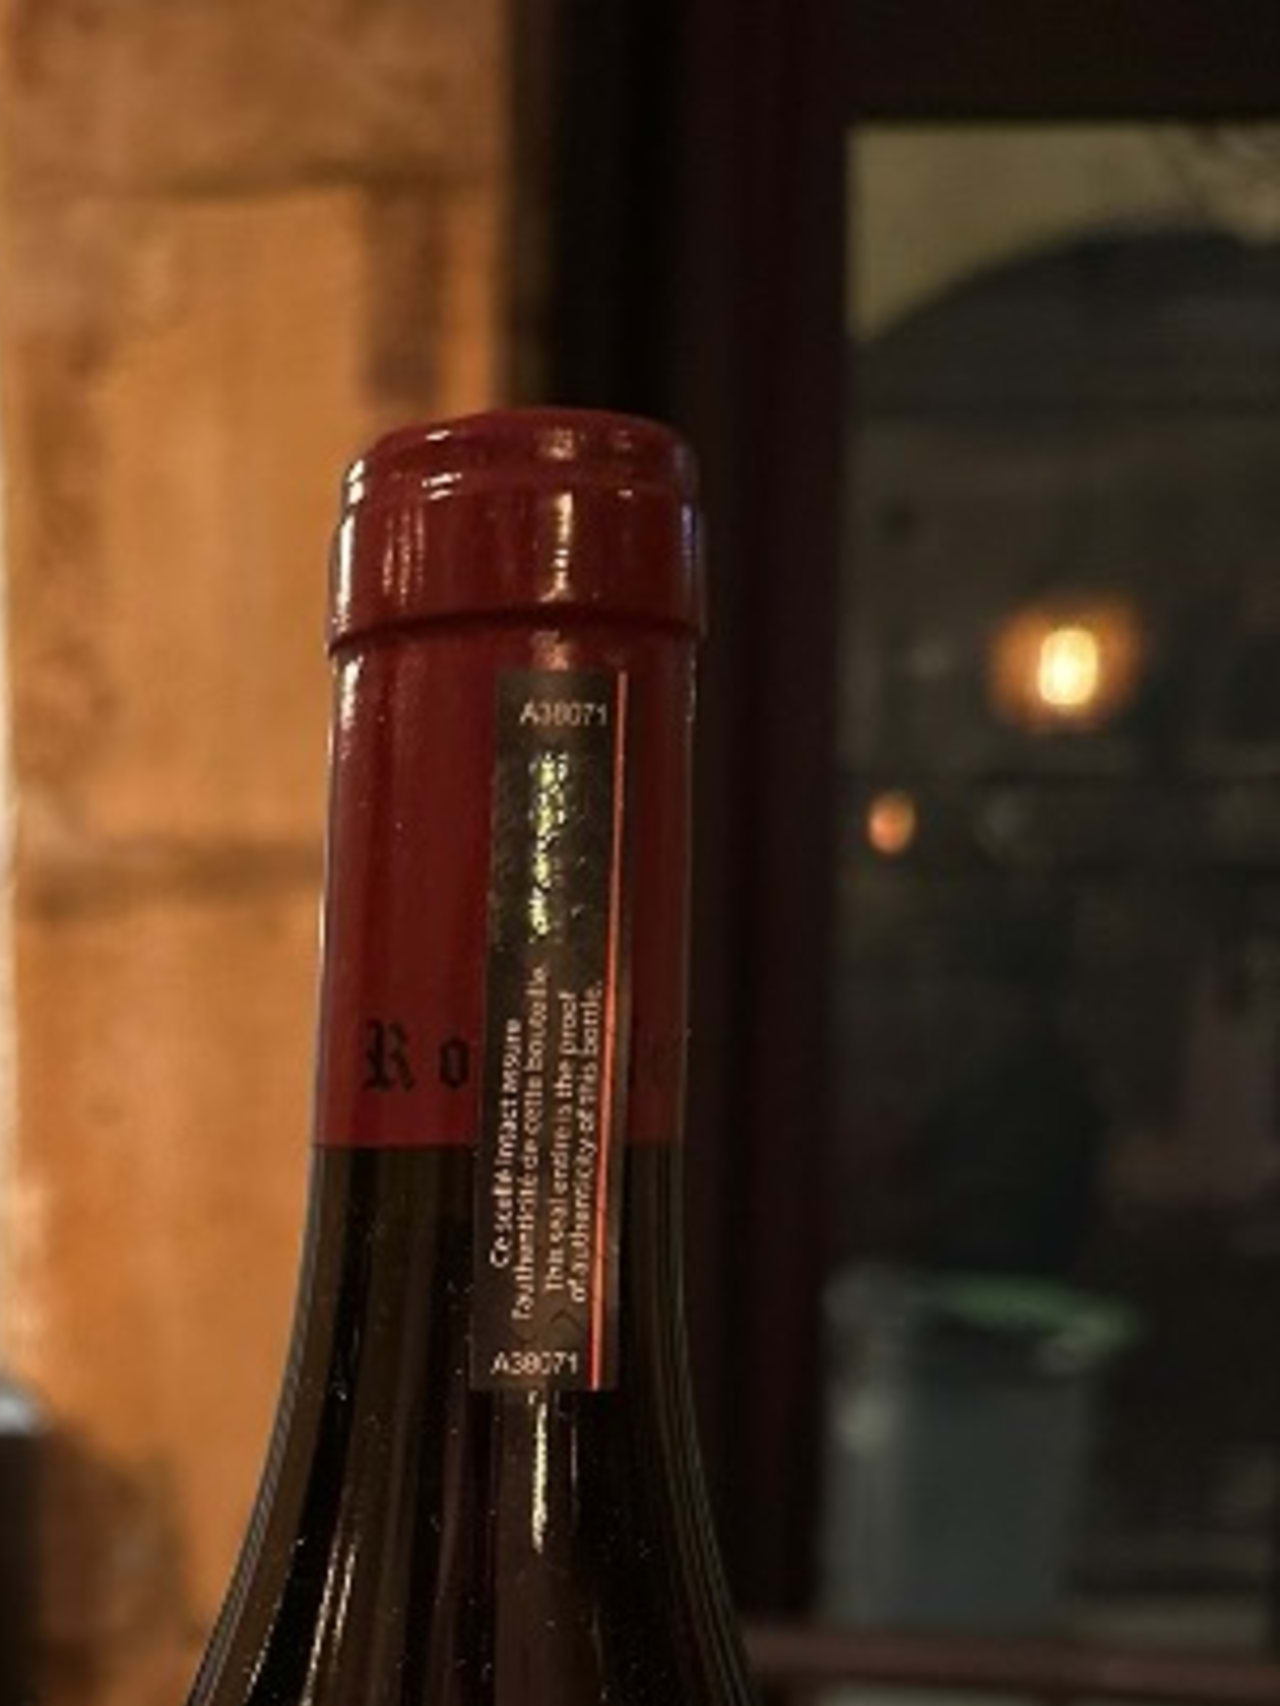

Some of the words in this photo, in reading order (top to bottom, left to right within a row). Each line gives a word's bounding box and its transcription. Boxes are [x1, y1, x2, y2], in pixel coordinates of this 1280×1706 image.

[519, 700, 607, 726] A38071
[557, 991, 579, 1056] proof
[554, 1062, 574, 1099] the
[578, 1062, 599, 1105] this
[523, 1075, 543, 1136] cette
[576, 1109, 596, 1132] of
[495, 1098, 519, 1166] intact
[522, 1139, 540, 1171] de
[550, 1126, 572, 1195] entire
[549, 1198, 569, 1244] seal
[570, 1139, 598, 1277] authenticity
[489, 1238, 513, 1268] Ce
[545, 1250, 565, 1292] This
[567, 1279, 588, 1303] of
[490, 1350, 579, 1376] A38071
